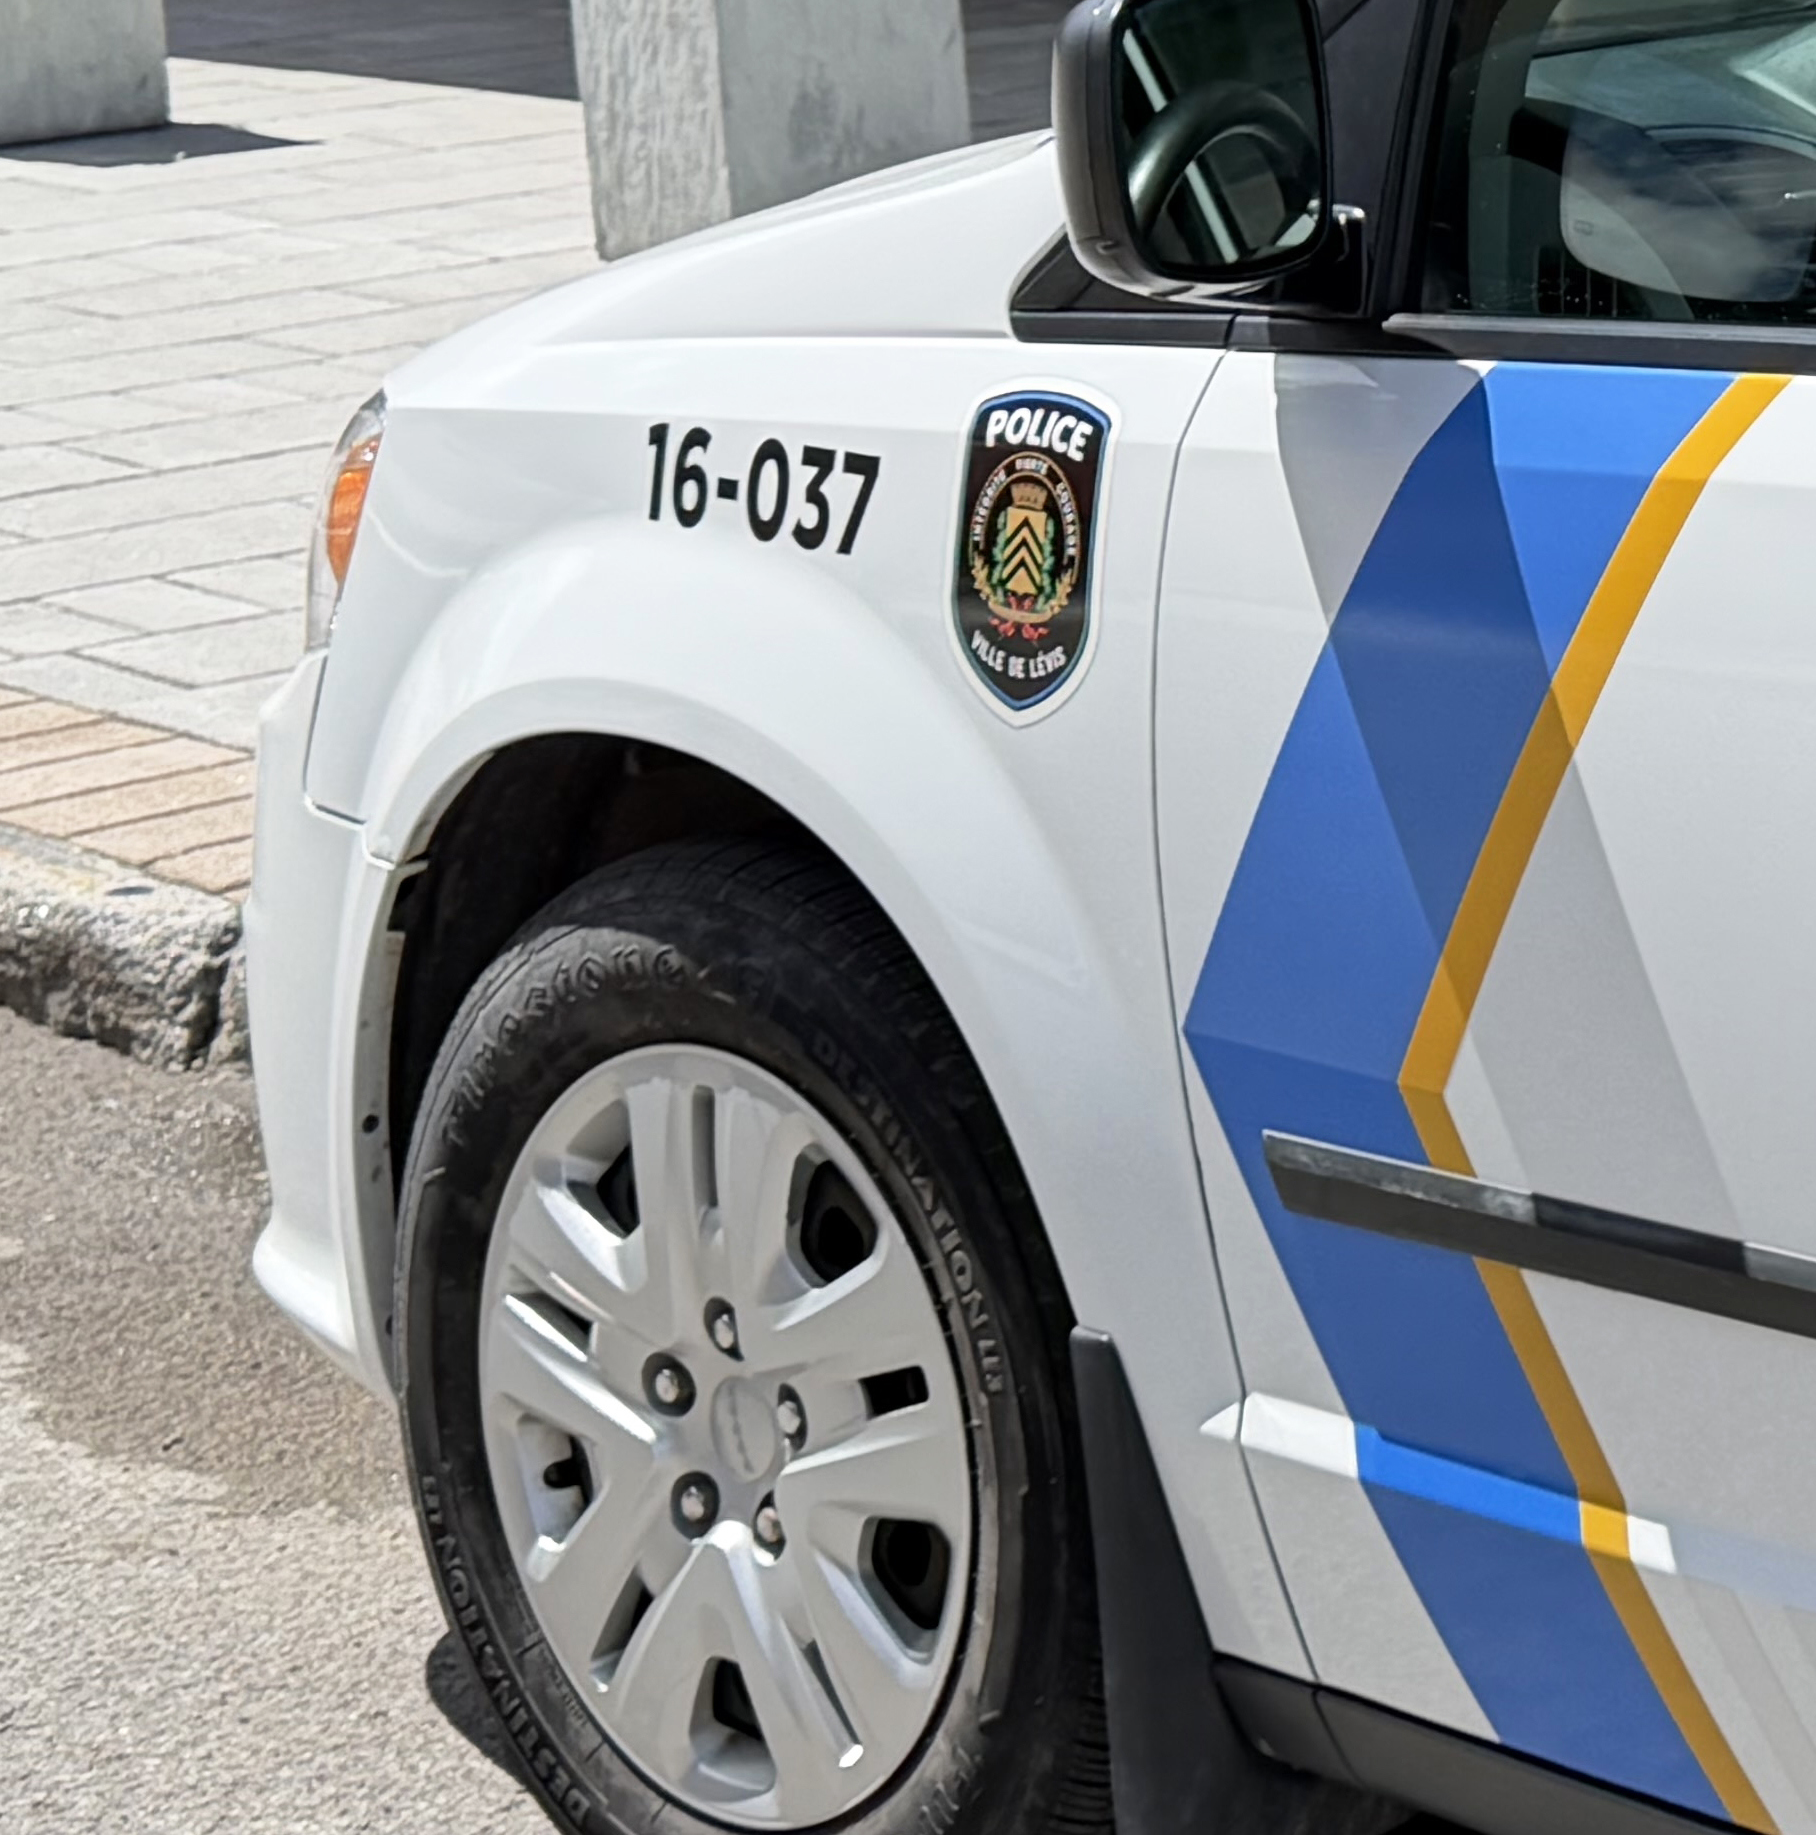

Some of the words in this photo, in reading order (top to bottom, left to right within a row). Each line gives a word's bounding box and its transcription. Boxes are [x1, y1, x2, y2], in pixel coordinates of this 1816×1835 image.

[985, 407, 1094, 462] POLICE
[647, 422, 882, 556] 16-037
[970, 628, 1007, 673] VILLE
[1007, 655, 1027, 679] DE
